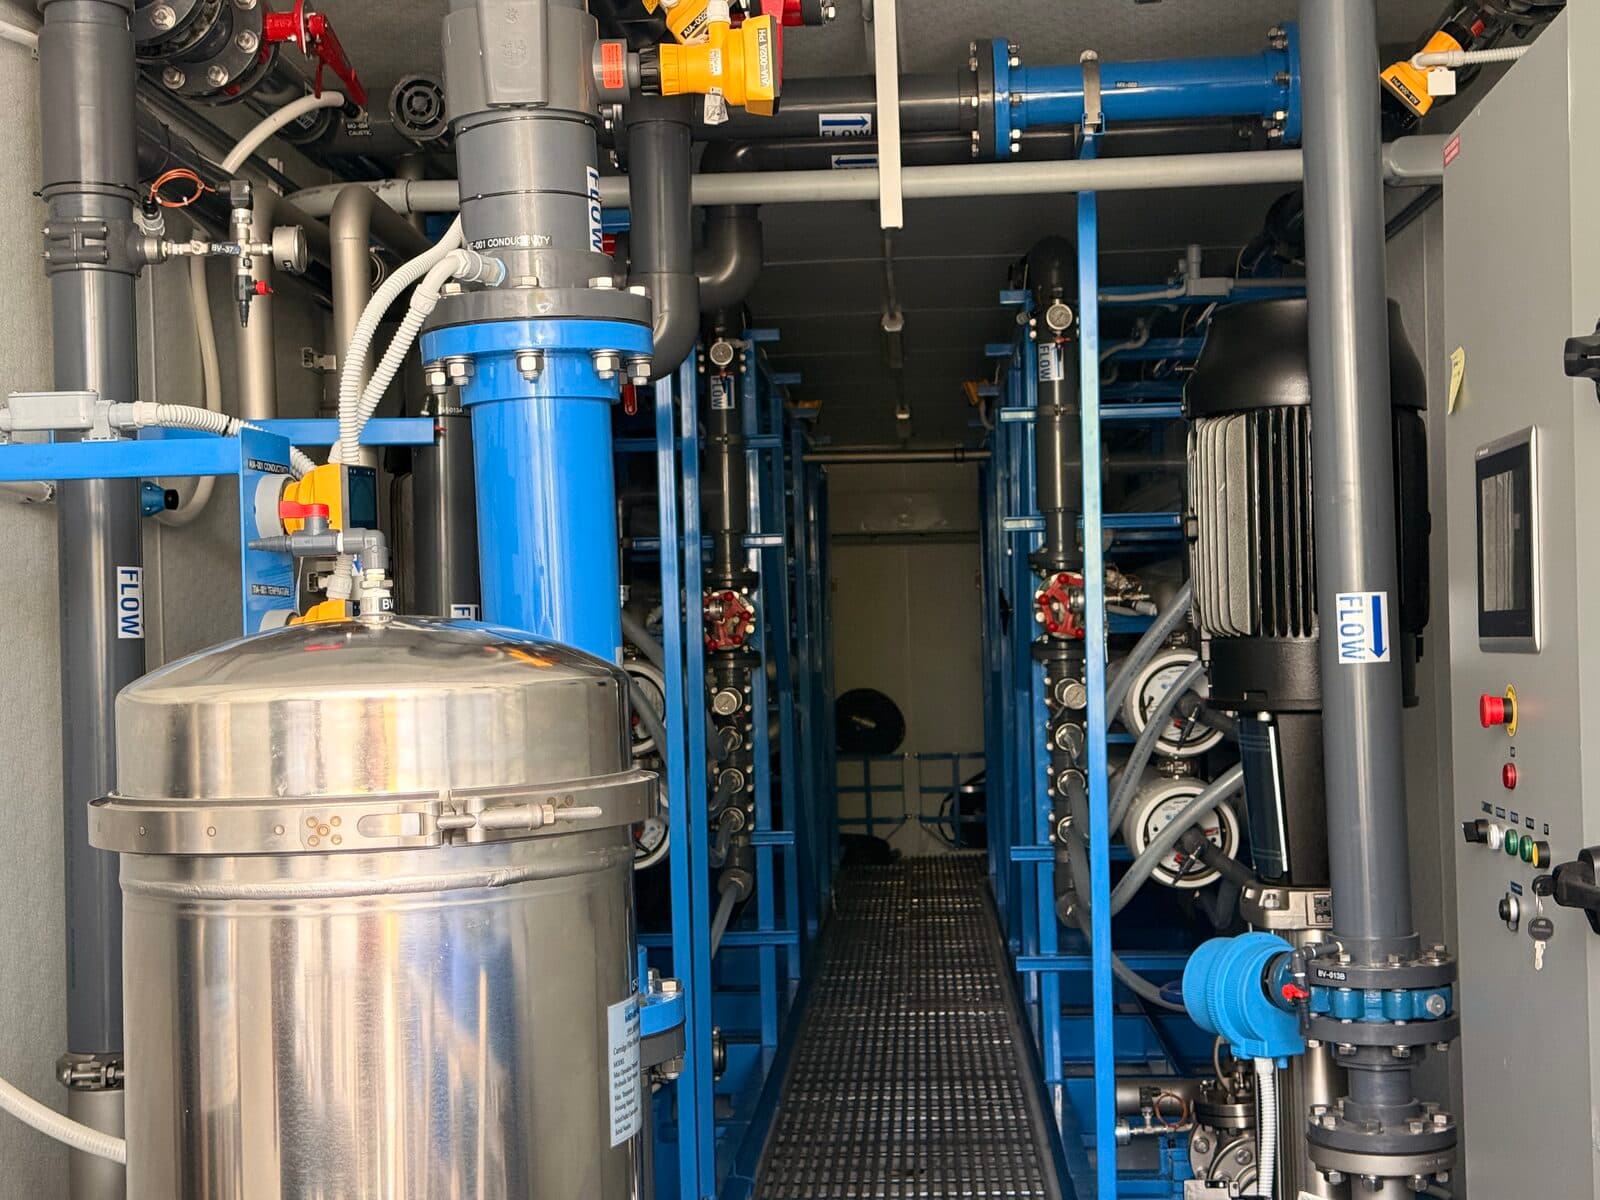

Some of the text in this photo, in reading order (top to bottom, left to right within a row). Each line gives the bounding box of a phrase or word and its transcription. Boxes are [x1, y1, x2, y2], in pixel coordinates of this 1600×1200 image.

[759, 29, 767, 42] PH
[589, 171, 602, 253] FLOW
[1039, 345, 1051, 380] FLOW
[711, 377, 724, 408] FLOW
[120, 569, 140, 636] FLOW
[1339, 596, 1366, 660] FLOW
